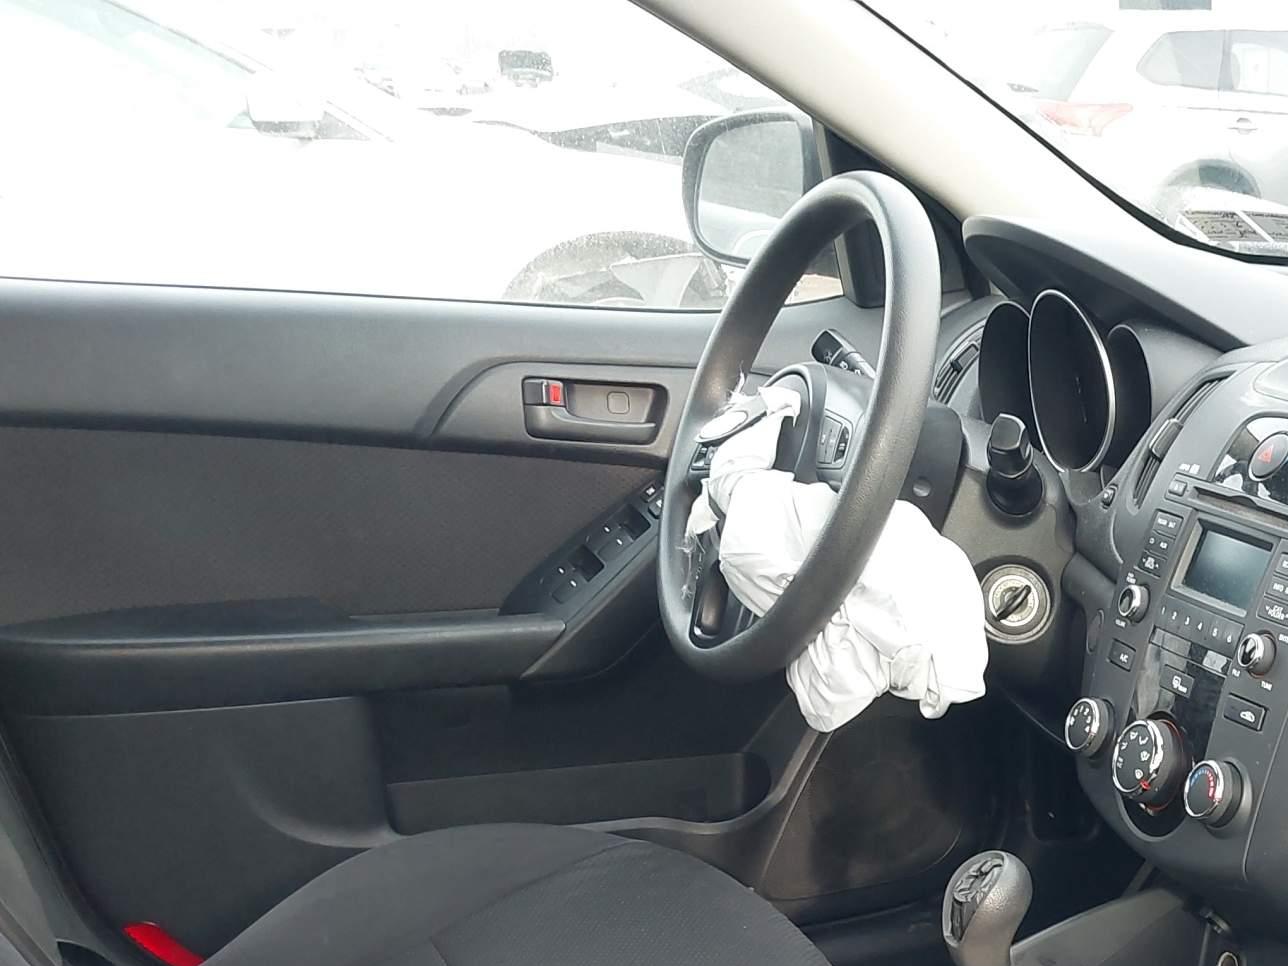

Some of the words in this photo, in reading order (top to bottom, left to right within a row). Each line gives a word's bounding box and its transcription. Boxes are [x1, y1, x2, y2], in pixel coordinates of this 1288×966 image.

[1172, 611, 1178, 620] 2
[1185, 616, 1190, 626] 3
[1197, 622, 1203, 631] 4
[1212, 628, 1218, 637] 5
[1226, 635, 1233, 643] 6
